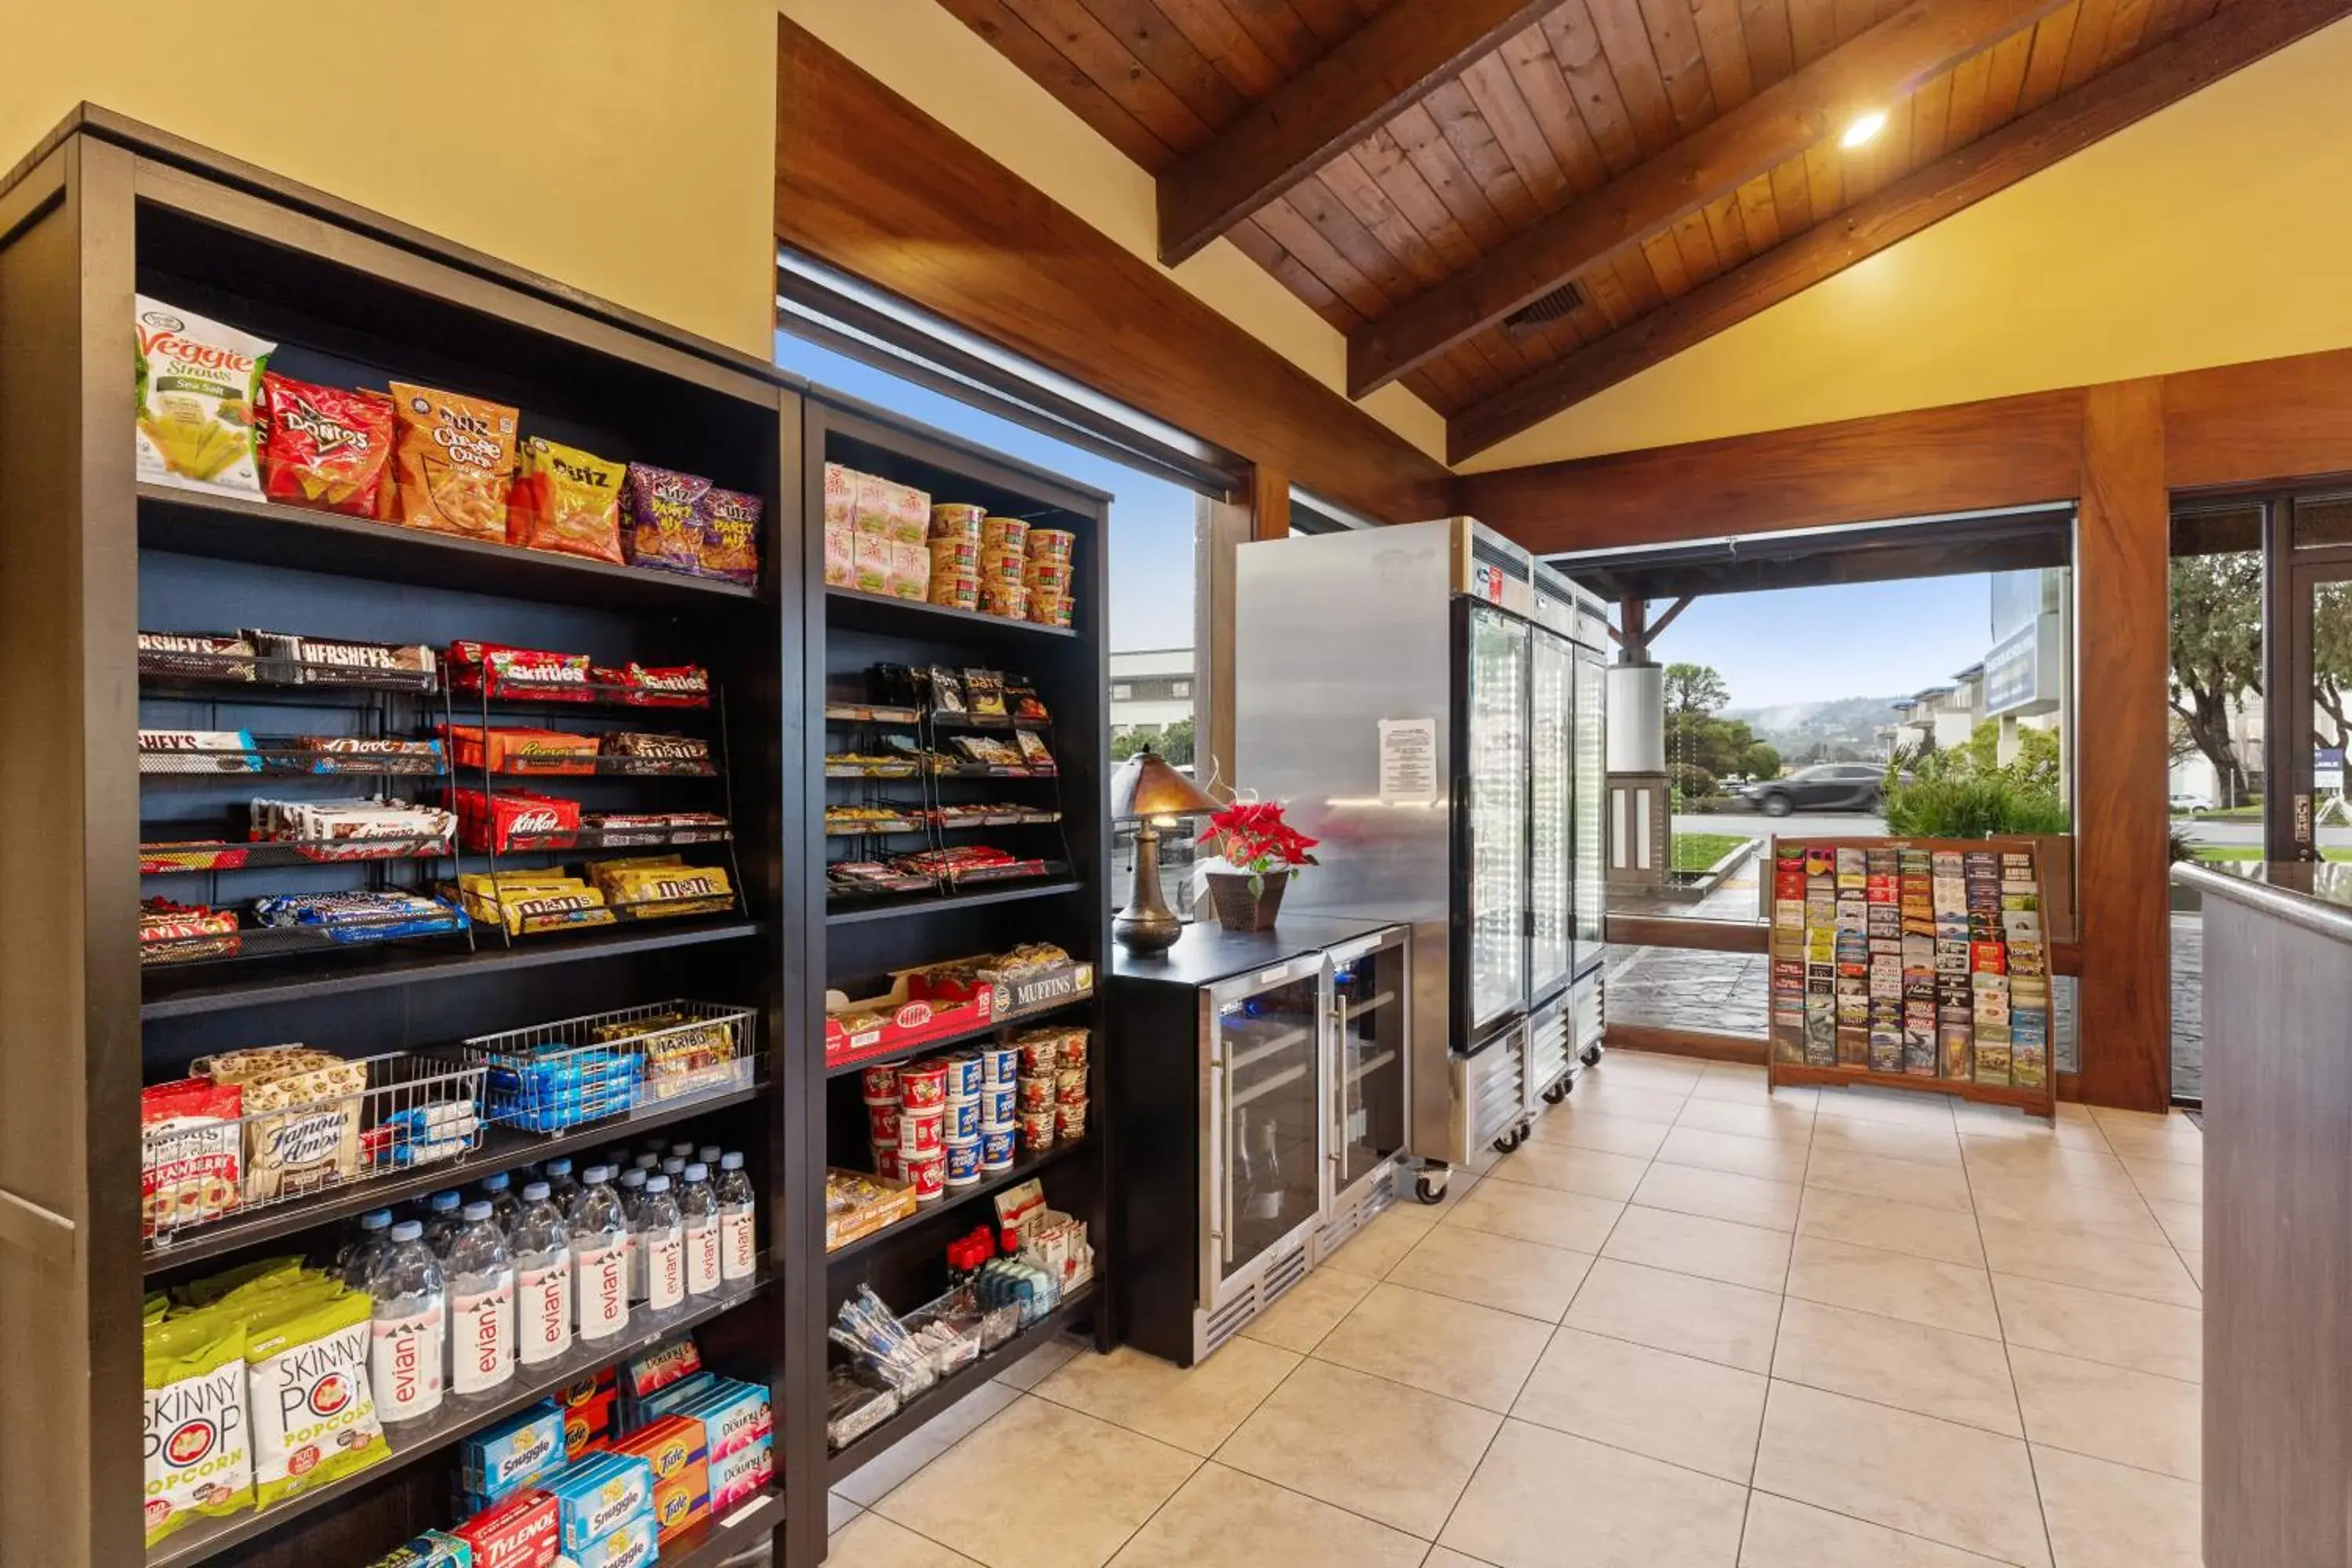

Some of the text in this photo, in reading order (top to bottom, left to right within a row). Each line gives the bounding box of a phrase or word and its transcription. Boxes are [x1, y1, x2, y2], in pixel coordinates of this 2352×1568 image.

[136, 324, 254, 372] Veggie
[166, 360, 233, 383] Straws
[432, 426, 502, 459] Cheese
[652, 497, 694, 518] PARTY
[660, 516, 683, 532] MIX
[713, 518, 755, 533] PARTY
[722, 532, 747, 550] MIX
[305, 643, 390, 669] HERSHEY'S
[978, 993, 990, 1008] 18
[1016, 975, 1072, 1006] MUFFINS
[263, 1112, 350, 1156] Famous
[270, 1135, 340, 1171] Amos
[706, 1237, 716, 1281] evian
[739, 1224, 749, 1268] evian
[666, 1248, 678, 1295] evian
[604, 1261, 619, 1321] evian
[545, 1283, 561, 1343] evian
[279, 1330, 365, 1388] SKINNY
[478, 1309, 498, 1374] evian
[396, 1335, 416, 1403] evian
[283, 1399, 376, 1448] POPCORN
[721, 1410, 758, 1436] Downy
[146, 1447, 243, 1496] OPCORN
[502, 1439, 550, 1476] Snuggle
[659, 1446, 684, 1471] Tide
[723, 1454, 760, 1483] Downy
[593, 1491, 639, 1531] Snuggle
[663, 1493, 688, 1518] Tide
[488, 1510, 556, 1566] TYLENOL
